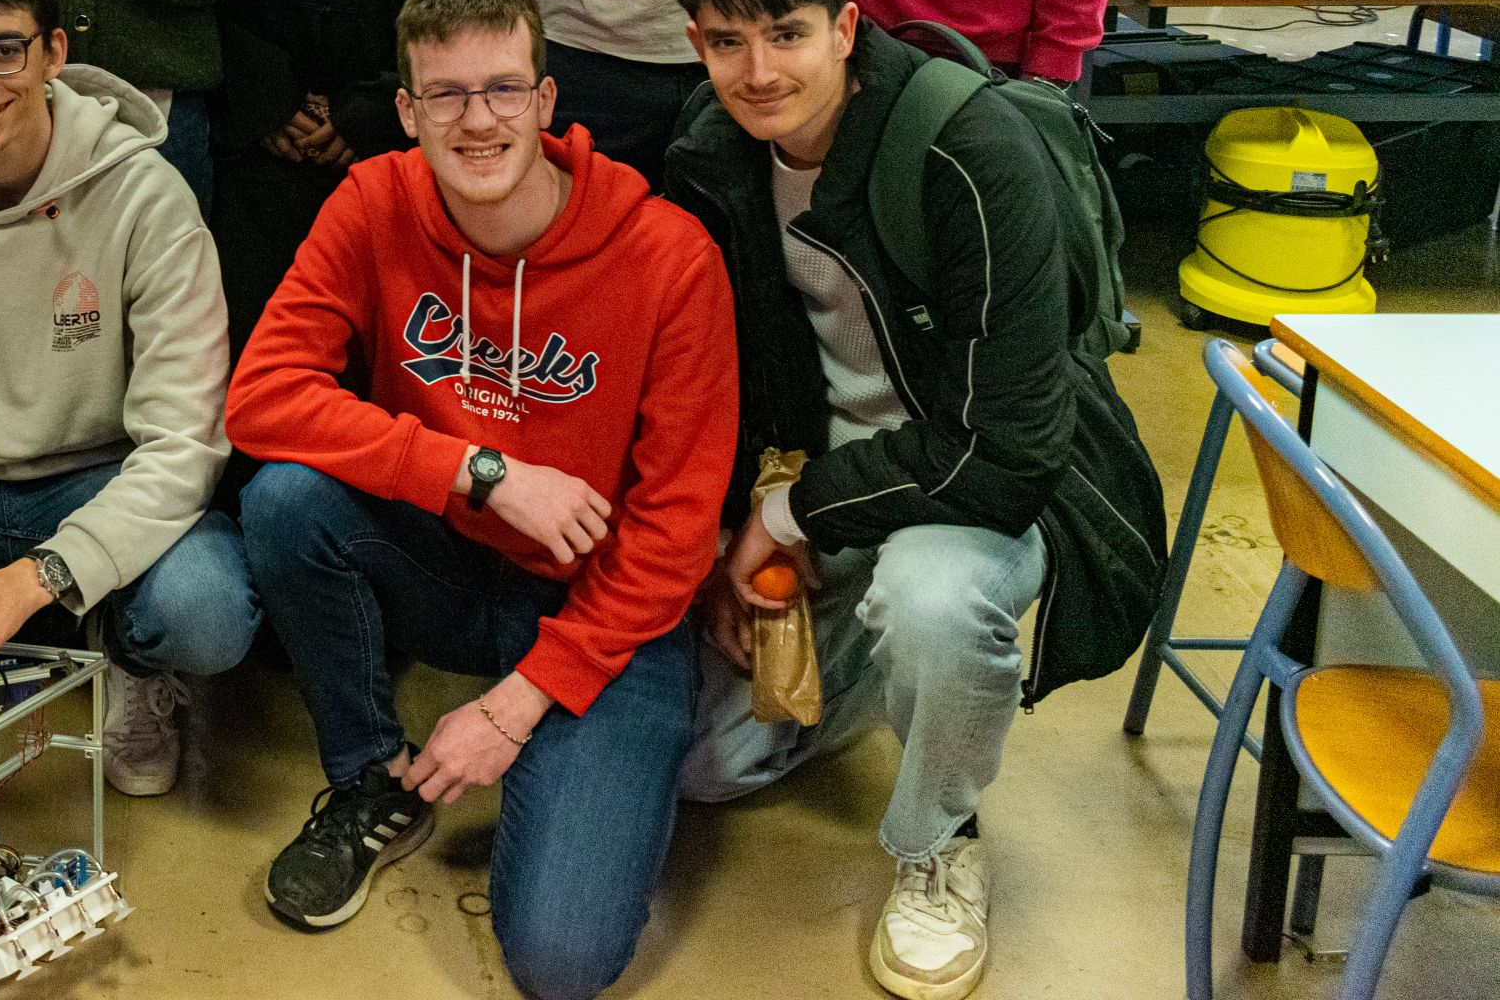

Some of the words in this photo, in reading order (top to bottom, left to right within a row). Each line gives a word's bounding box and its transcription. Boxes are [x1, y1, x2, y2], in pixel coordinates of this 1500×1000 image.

[403, 292, 600, 396] Creeks
[461, 400, 488, 416] Since
[493, 408, 520, 424] 1974
